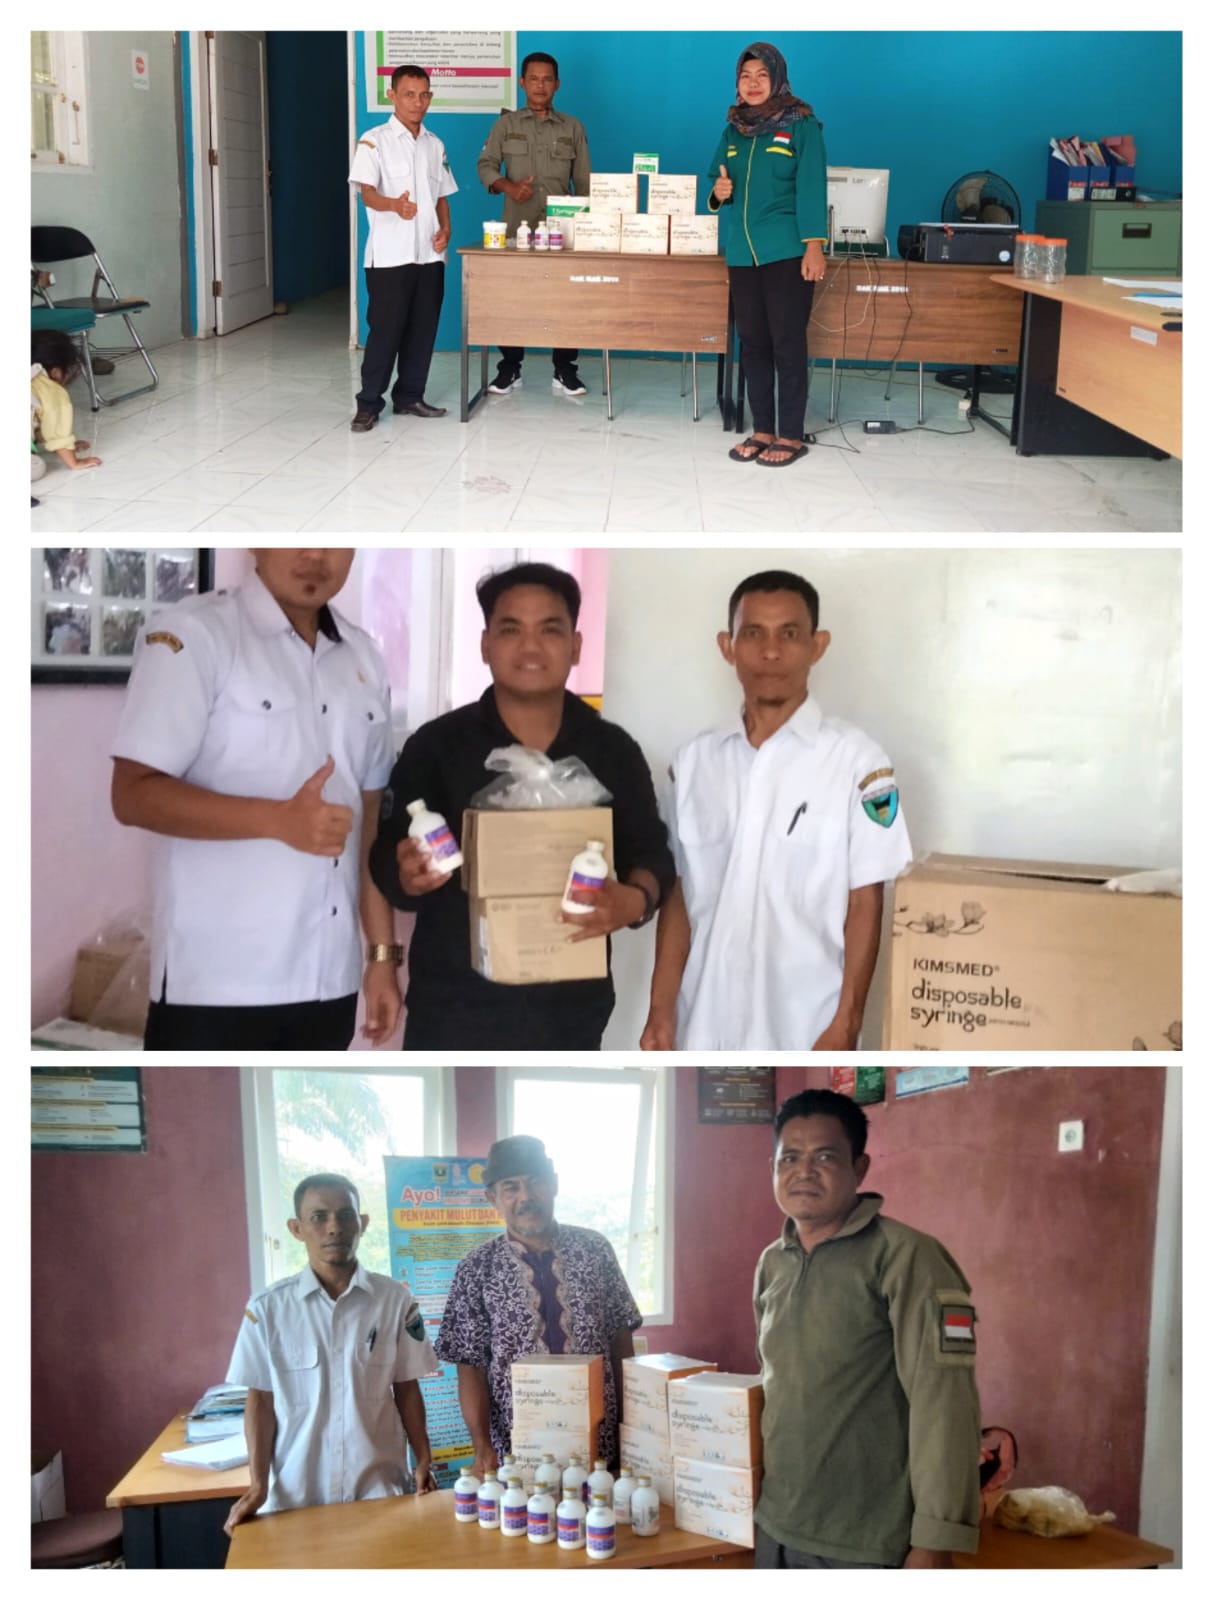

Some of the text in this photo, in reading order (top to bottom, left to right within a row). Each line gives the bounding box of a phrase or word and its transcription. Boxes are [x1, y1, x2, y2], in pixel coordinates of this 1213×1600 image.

[430, 68, 457, 77] Motto
[911, 977, 1022, 1010] disposable
[910, 1002, 987, 1033] syringe
[402, 1186, 441, 1207] Ayo!
[400, 1208, 497, 1222] PENYAKIT MULUT DAN
